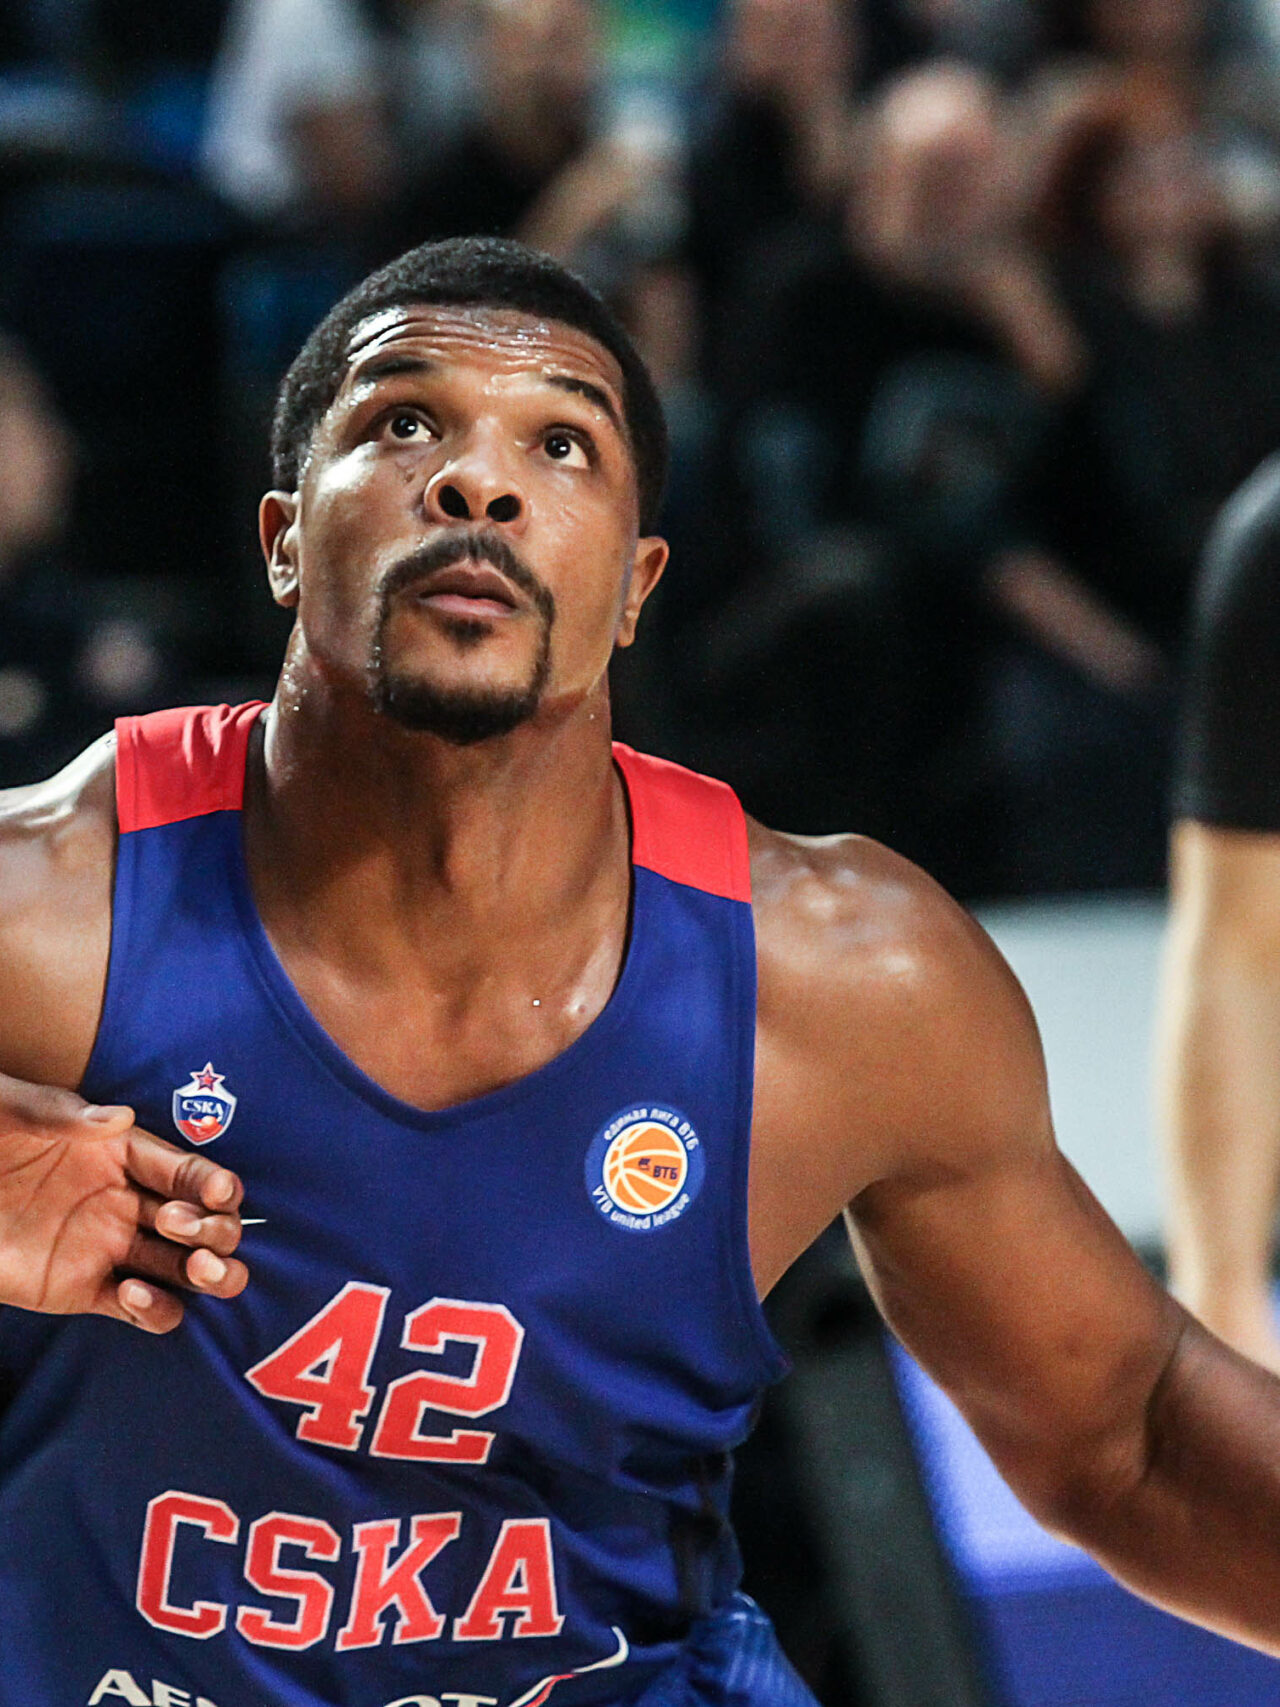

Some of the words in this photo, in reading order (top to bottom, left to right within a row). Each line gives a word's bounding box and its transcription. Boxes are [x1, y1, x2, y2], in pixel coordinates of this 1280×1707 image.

[181, 1098, 225, 1116] CSKA
[652, 1164, 679, 1181] ВТБ
[592, 1184, 614, 1214] VTB
[244, 1280, 525, 1464] 42
[135, 1489, 566, 1652] CSKA
